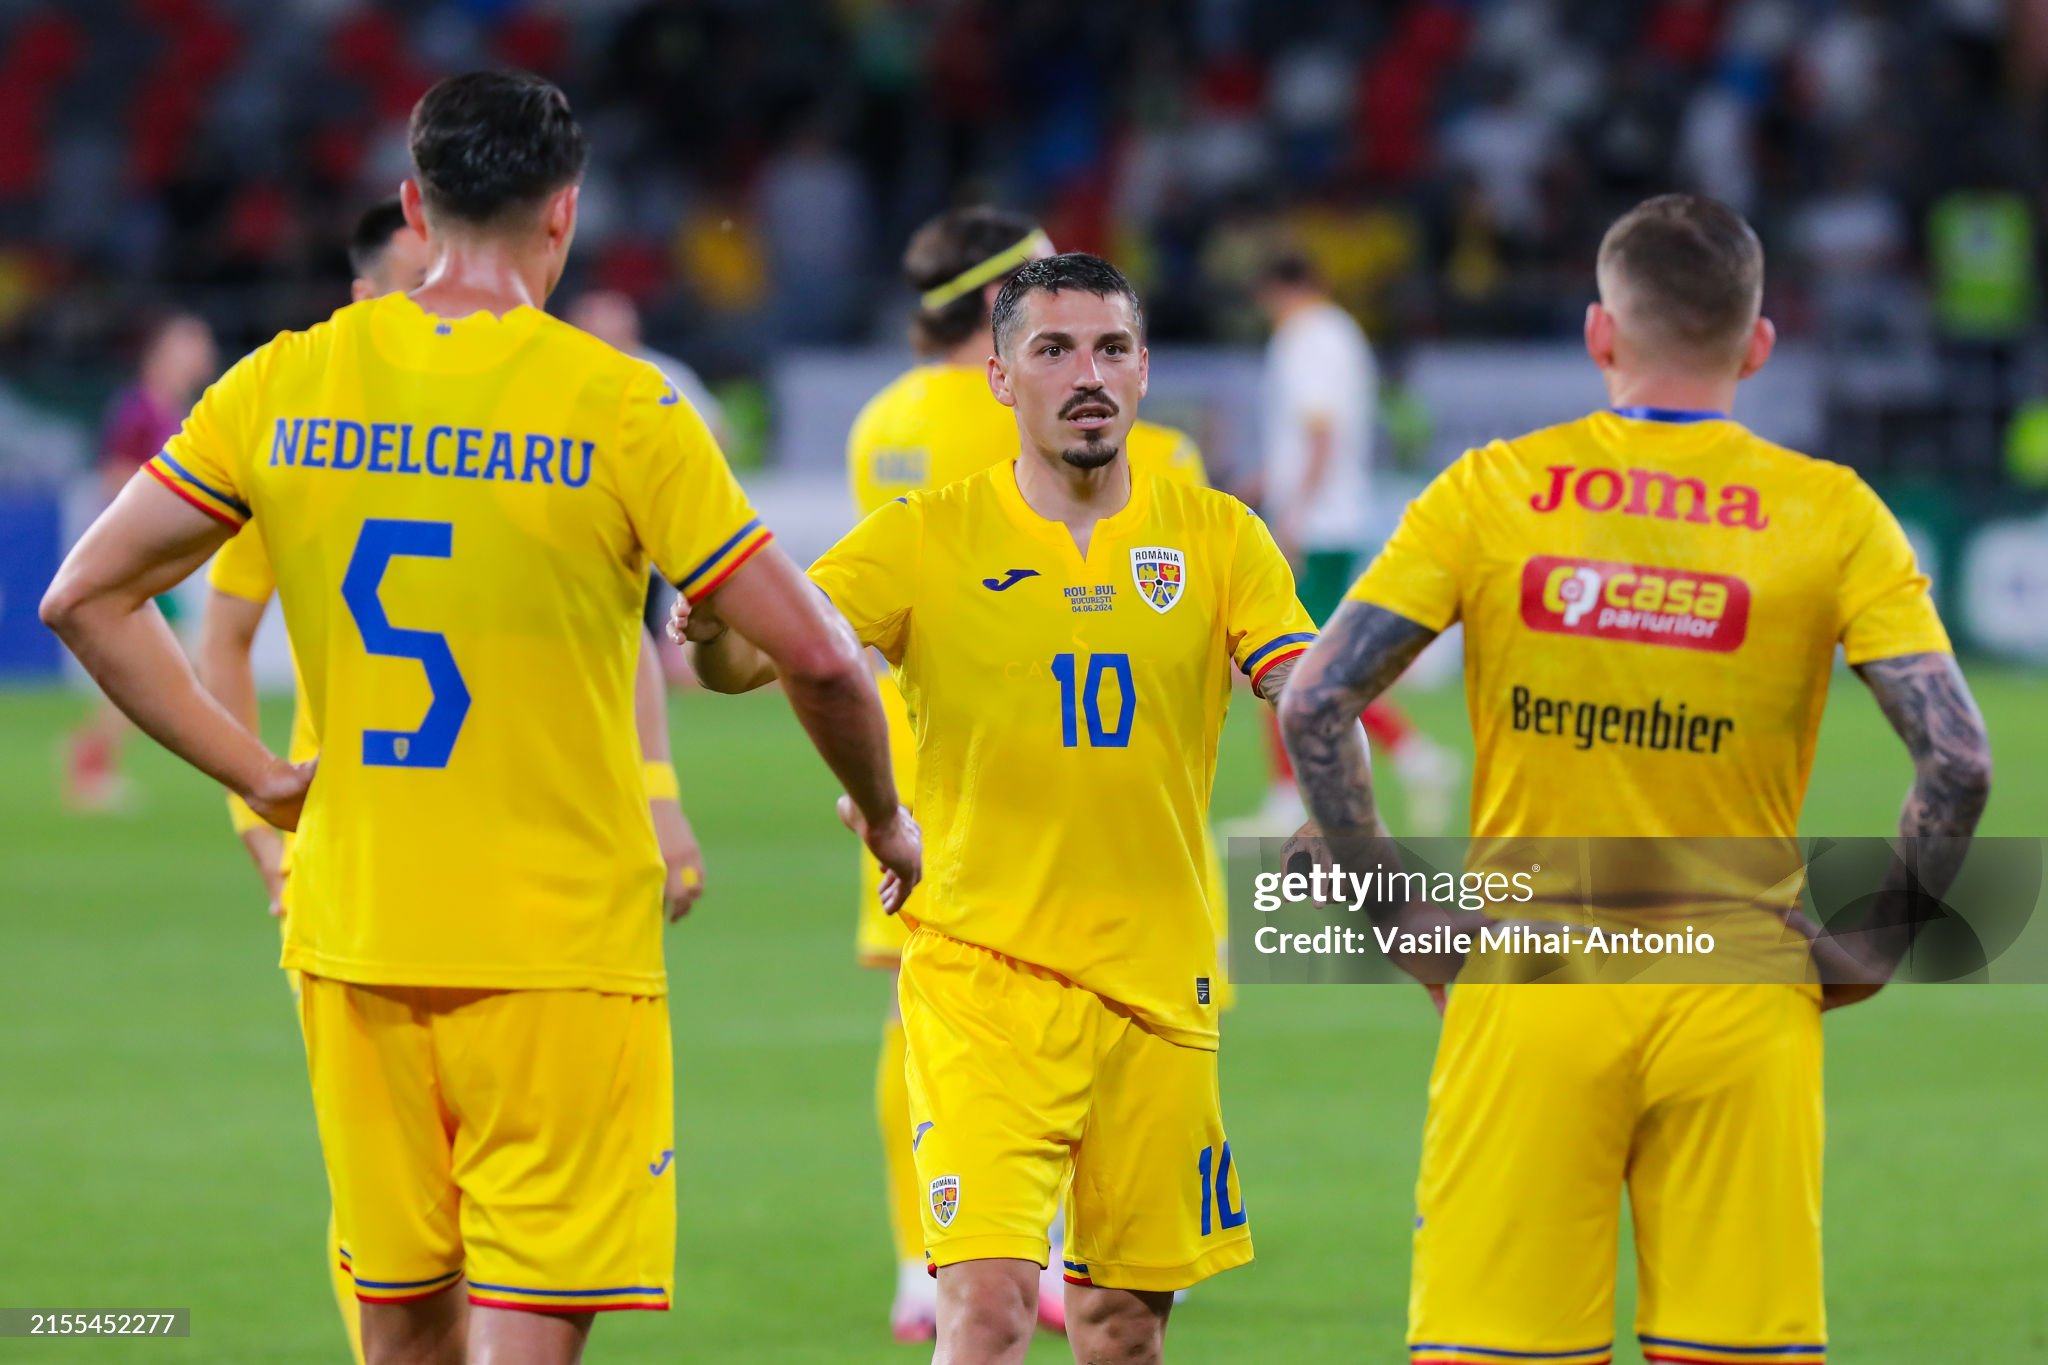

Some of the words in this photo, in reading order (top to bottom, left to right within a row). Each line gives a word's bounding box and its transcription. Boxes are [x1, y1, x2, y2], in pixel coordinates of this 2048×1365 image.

[269, 418, 595, 488] NEDELCEARU
[1135, 549, 1179, 562] ROMÂNIA
[1063, 586, 1086, 597] ROU
[1095, 585, 1117, 595] BUL
[1072, 603, 1113, 613] 04.06.2024
[1604, 572, 1728, 619] casa
[340, 517, 472, 769] 5
[1598, 607, 1719, 638] pariurilor
[1051, 653, 1137, 748] 10
[1512, 685, 1735, 754] Bergenbier
